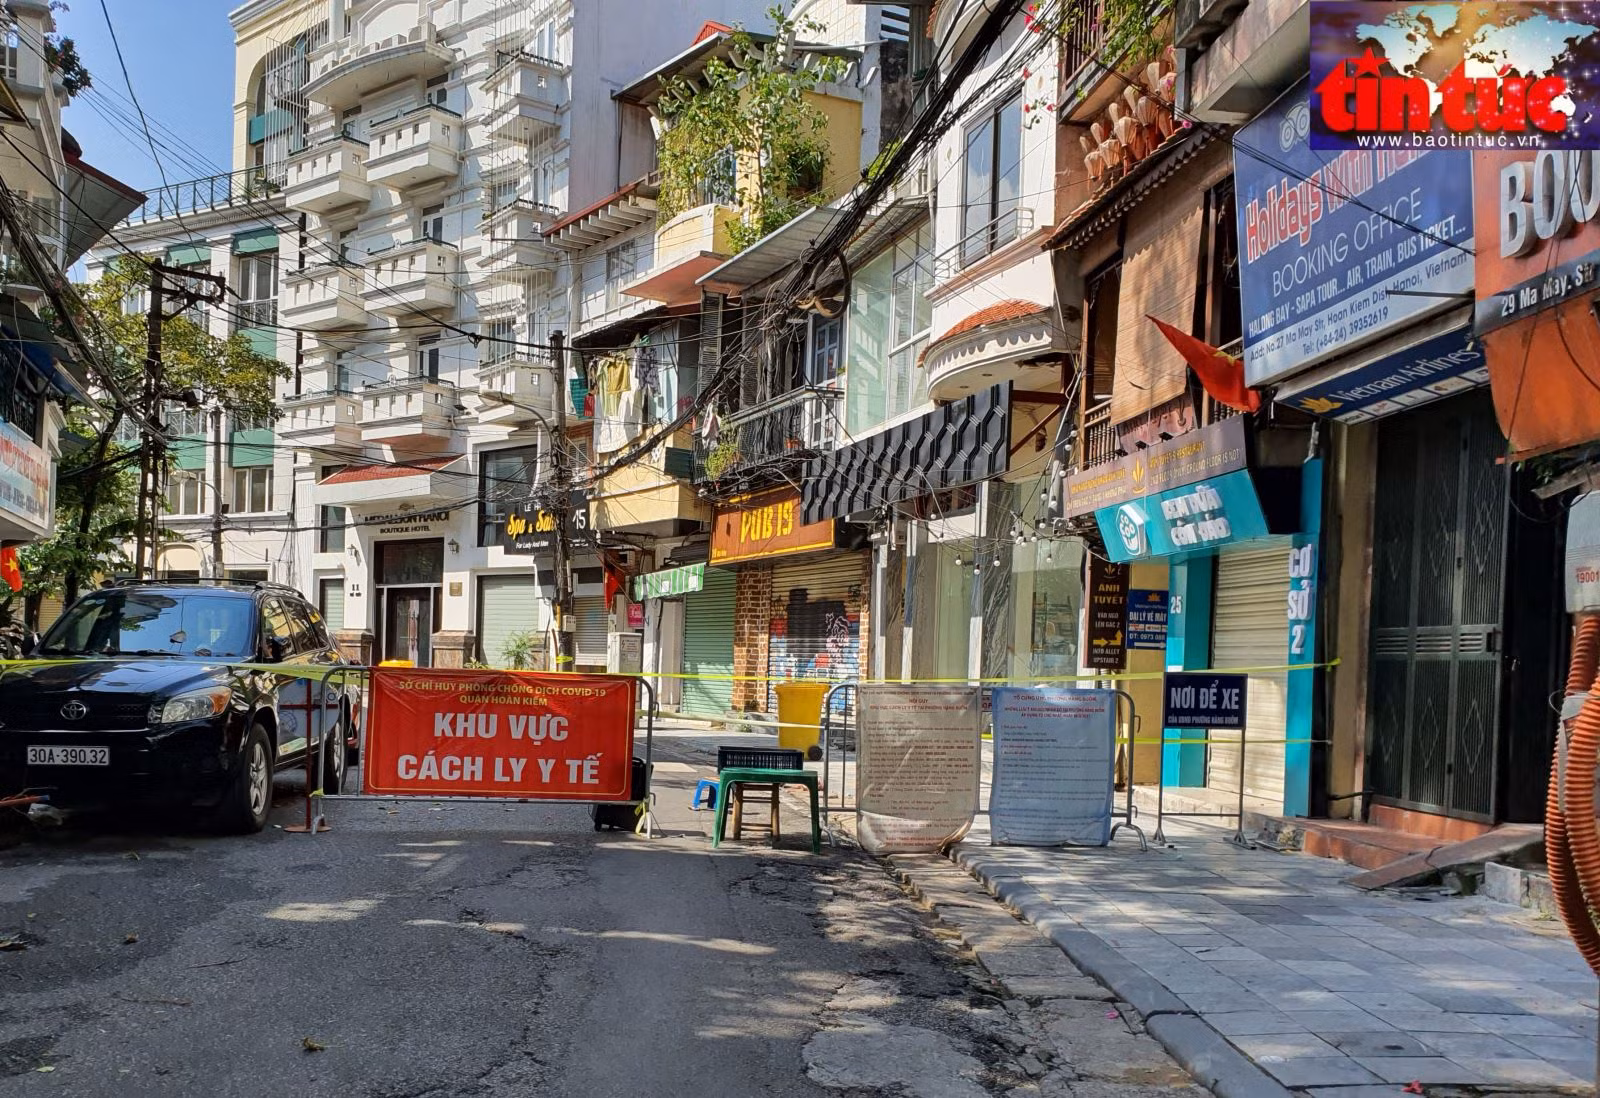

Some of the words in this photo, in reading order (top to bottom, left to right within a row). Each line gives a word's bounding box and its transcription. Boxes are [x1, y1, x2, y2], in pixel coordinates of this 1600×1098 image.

[1246, 172, 1322, 264] Holidays
[1272, 232, 1349, 298] BOOKING
[1353, 187, 1421, 251] OFFICE
[1248, 312, 1276, 338] HALONG
[1274, 307, 1290, 329] BAY
[1296, 290, 1317, 316] SAPA
[1346, 267, 1364, 290] AIR,
[1365, 252, 1396, 280] TRAIN,
[1397, 237, 1418, 264] BUS
[1501, 295, 1516, 317] 29
[1519, 286, 1538, 310] Ma
[1250, 344, 1266, 361] Add:
[1298, 324, 1314, 345] May
[1327, 308, 1349, 325] Hoan
[1350, 298, 1371, 317] Kiem
[1425, 252, 1468, 280] Vietnam
[1349, 306, 1389, 335] 39352619
[1328, 366, 1406, 403] Vietnam
[1401, 349, 1481, 382] Airlines
[380, 526, 410, 534] BOUTIQUE
[411, 525, 431, 533] HOTEL
[507, 513, 526, 541] Spa
[572, 508, 587, 530] 15
[740, 505, 773, 544] PUB
[1288, 543, 1312, 578] CƠ
[1170, 595, 1182, 614] 25
[1287, 579, 1311, 621] SỞ
[1291, 624, 1305, 655] 2
[434, 682, 457, 692] HUY
[535, 686, 559, 698] DỊCH
[561, 687, 606, 697] COVID-19
[1170, 685, 1196, 709] NƠI
[1199, 679, 1219, 709] ĐỂ
[1221, 688, 1240, 710] XE
[434, 712, 498, 739] KHU
[509, 713, 569, 746] VỰC
[29, 748, 108, 765] 30A-390.32
[397, 746, 483, 781] CÁCH
[494, 757, 527, 783] LY
[537, 758, 558, 784] Y
[565, 752, 604, 785] TẾ
